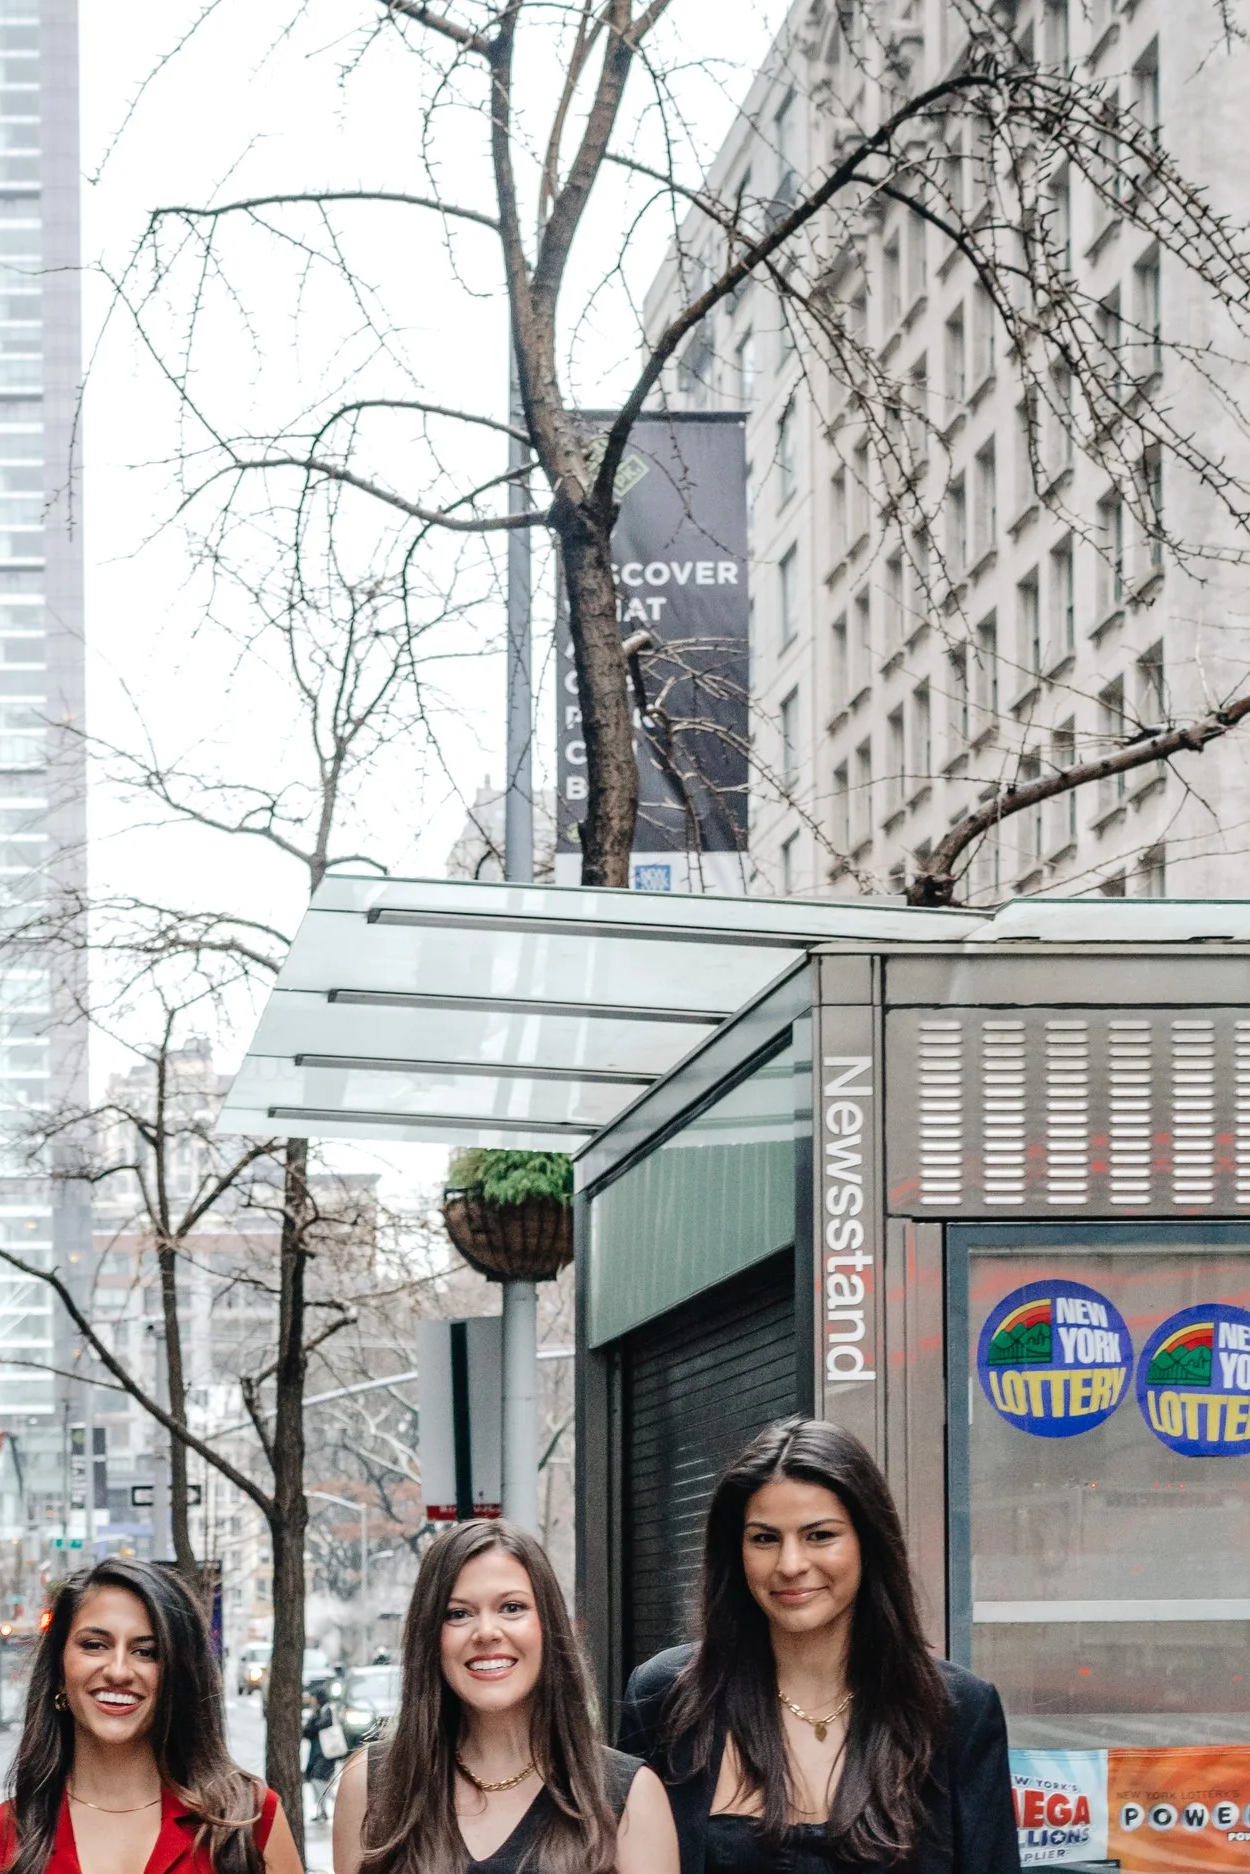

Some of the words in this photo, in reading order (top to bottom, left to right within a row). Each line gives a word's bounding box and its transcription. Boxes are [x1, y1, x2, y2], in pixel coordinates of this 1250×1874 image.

[611, 561, 738, 587] COVER
[823, 1056, 876, 1381] Newsstand
[1056, 1297, 1108, 1328] NEW
[1058, 1327, 1121, 1364] YORK
[989, 1367, 1126, 1418] LOTTERY
[1147, 1390, 1250, 1442] LOTTE
[1146, 1791, 1176, 1801] YORK
[1125, 1806, 1250, 1827] POWE
[1019, 1828, 1090, 1847] LIONS
[1024, 1849, 1066, 1862] PLIER
